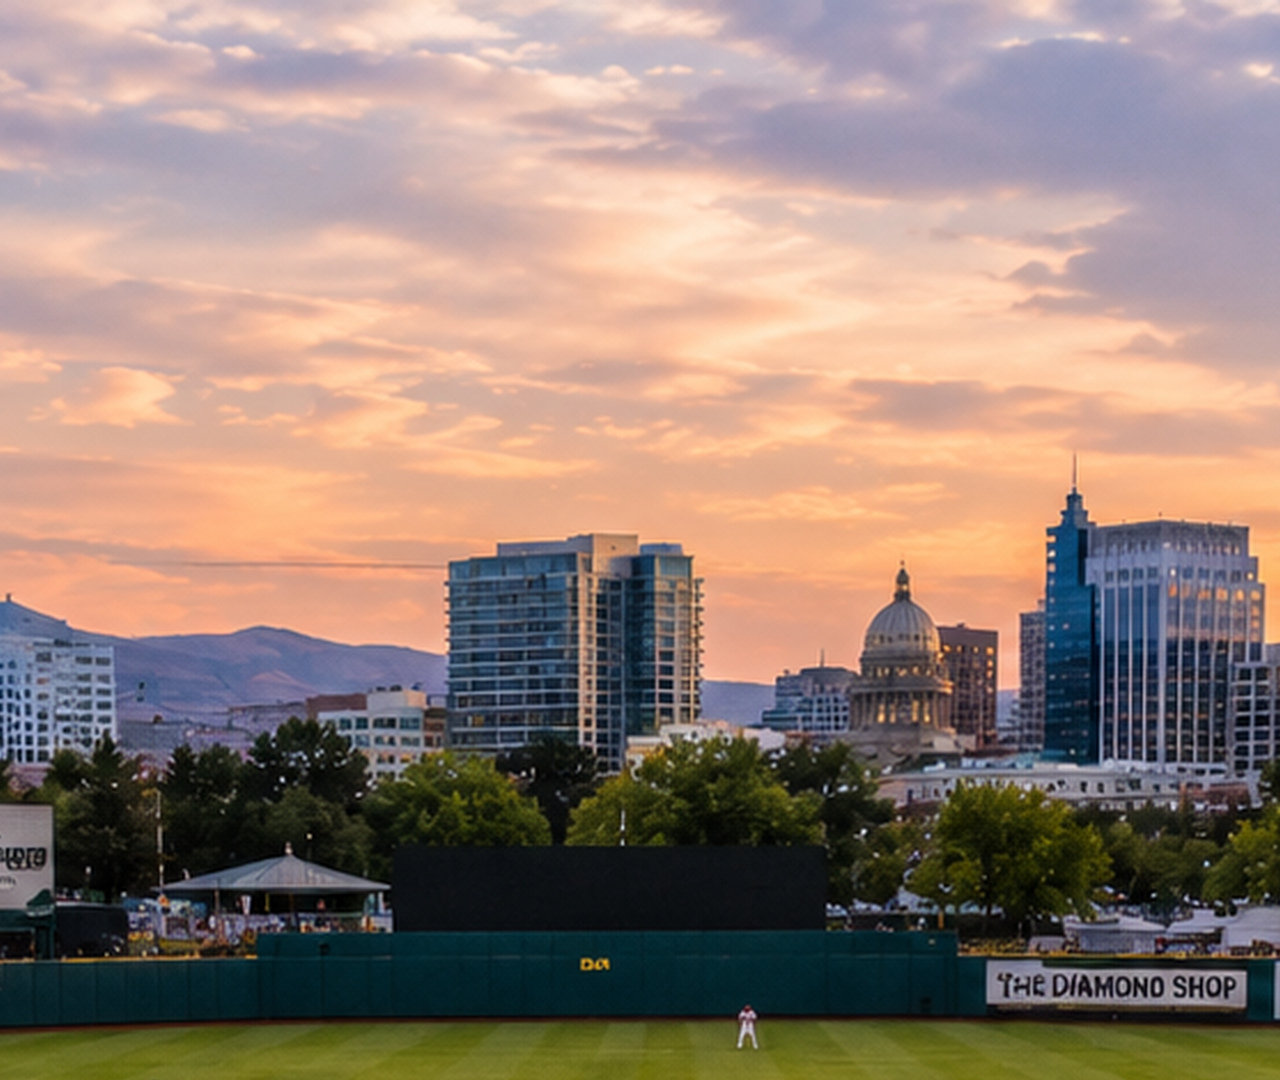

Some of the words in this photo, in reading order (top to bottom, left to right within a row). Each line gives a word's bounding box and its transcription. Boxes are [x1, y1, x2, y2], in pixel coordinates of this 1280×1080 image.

[997, 970, 1045, 998] THE
[1052, 972, 1164, 999] DIAMOND
[1173, 975, 1237, 1001] SHOP
